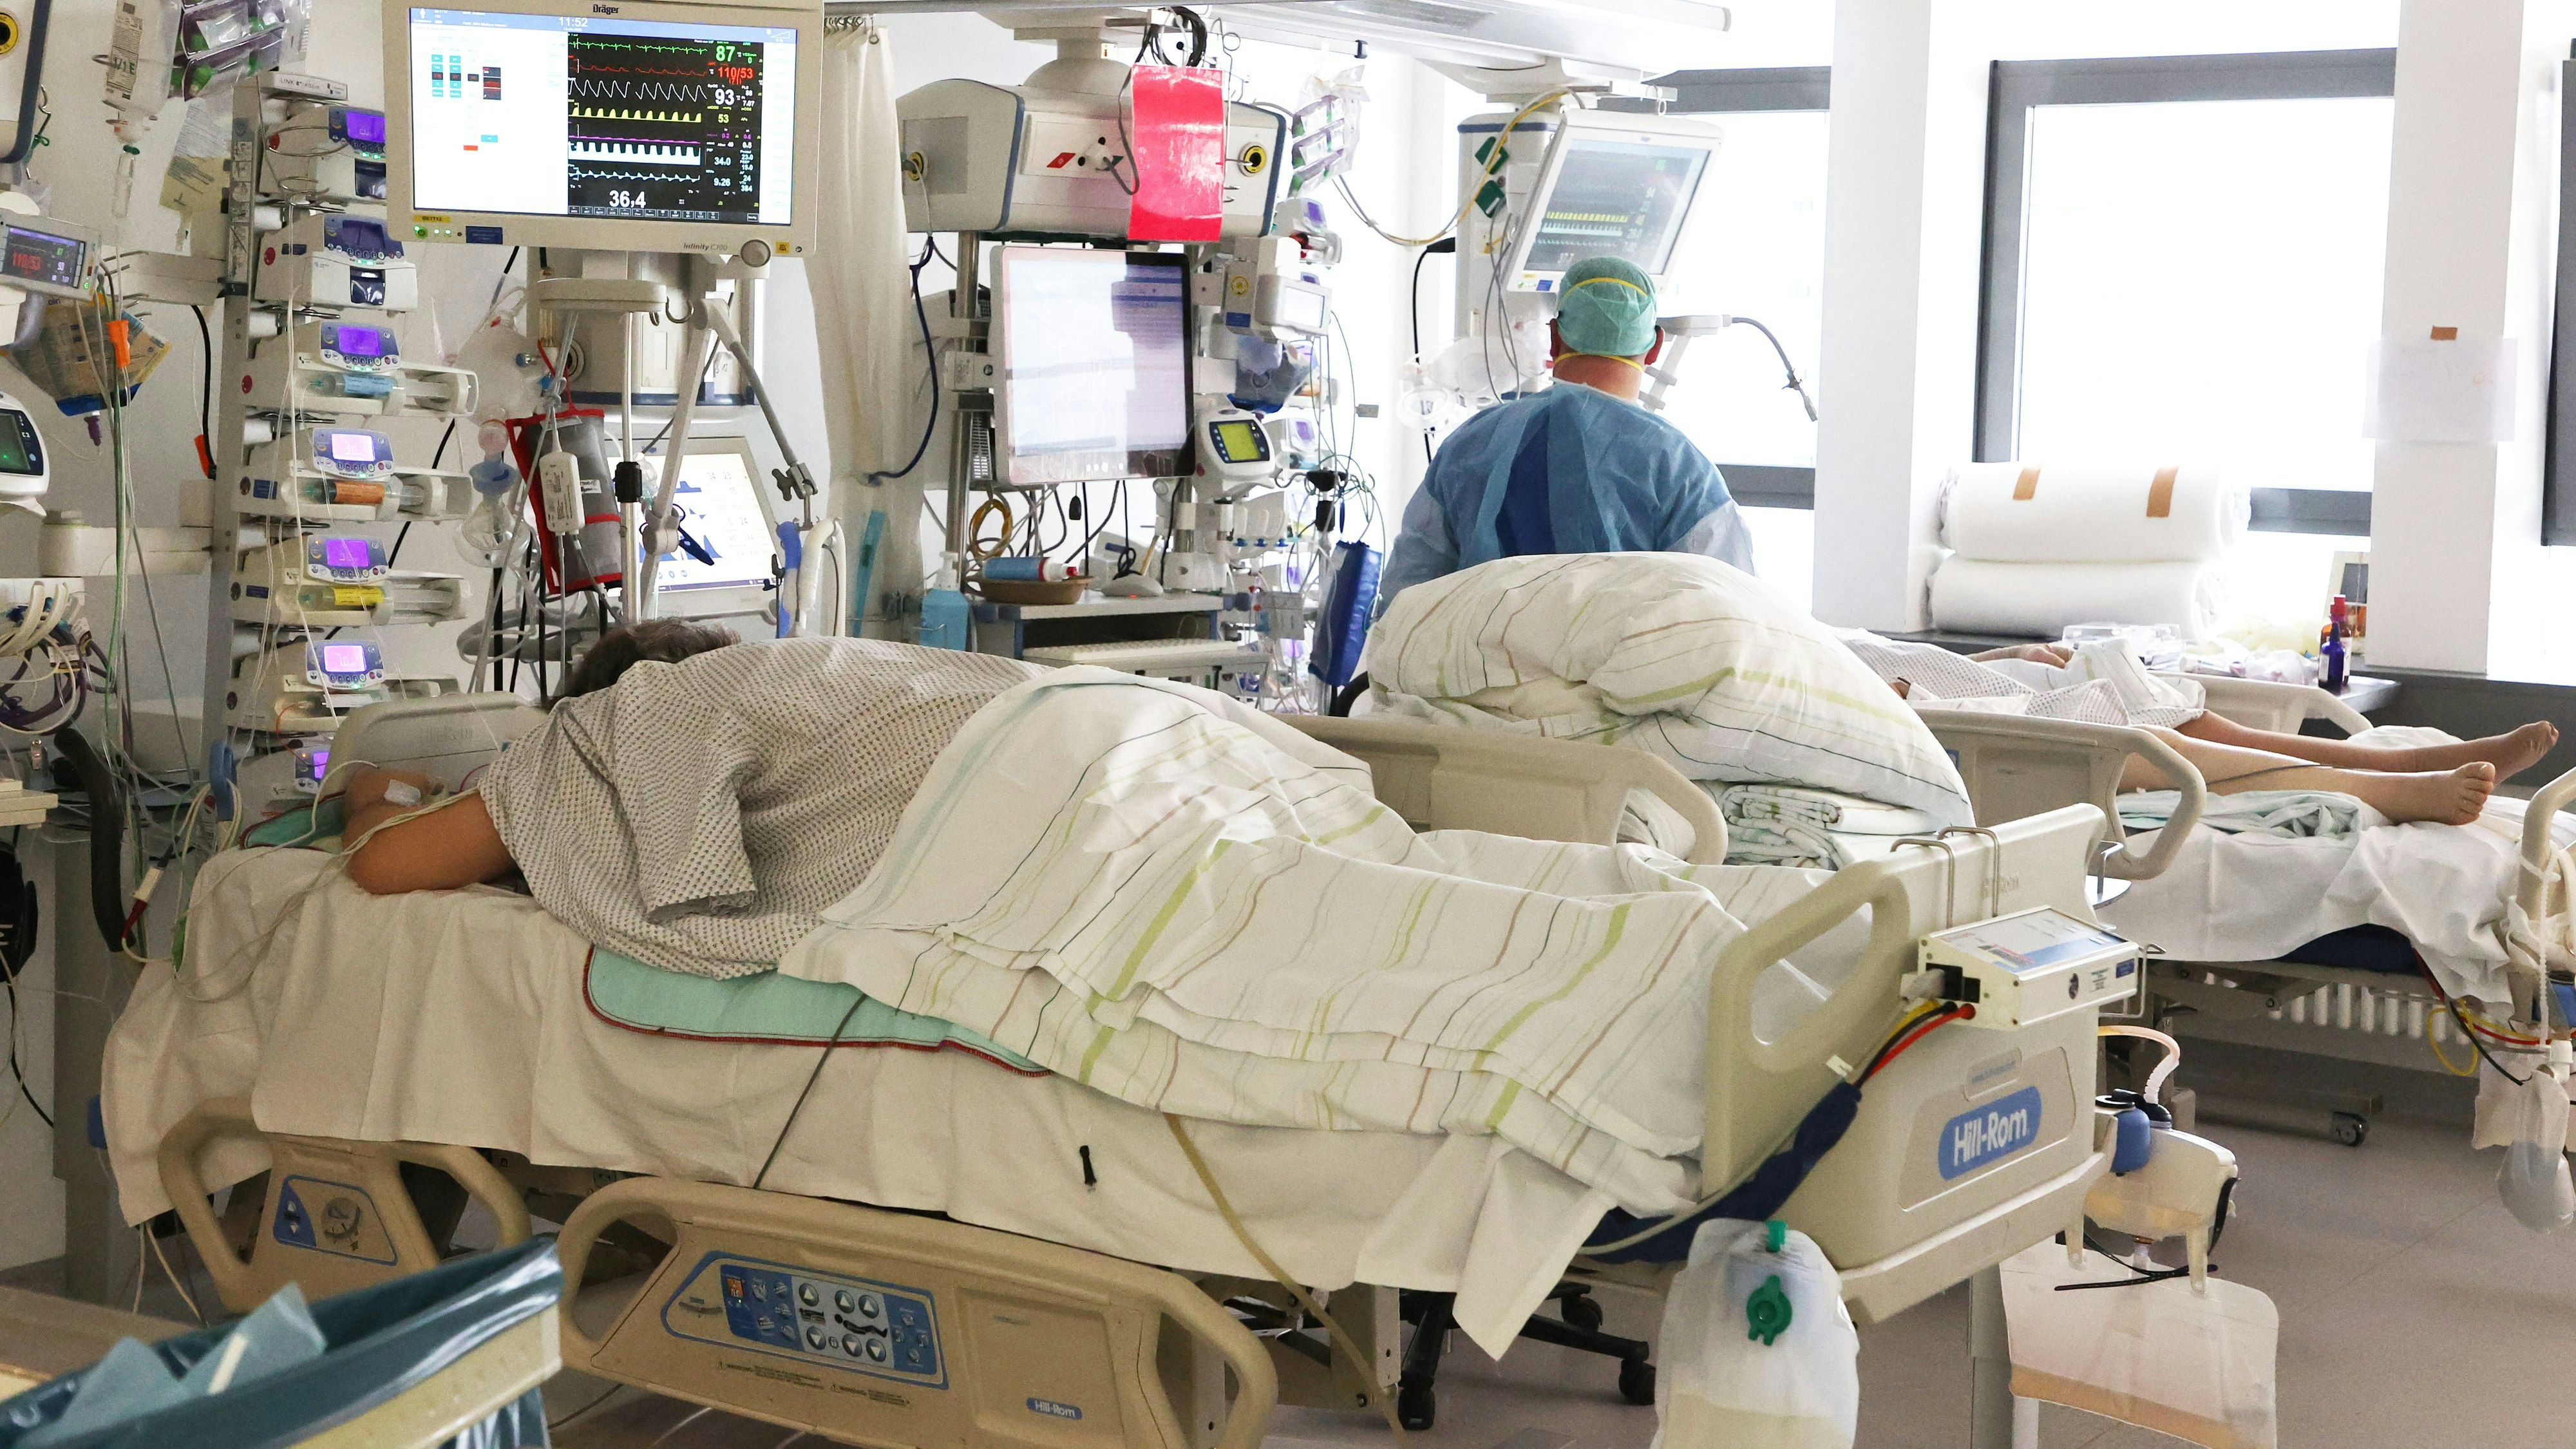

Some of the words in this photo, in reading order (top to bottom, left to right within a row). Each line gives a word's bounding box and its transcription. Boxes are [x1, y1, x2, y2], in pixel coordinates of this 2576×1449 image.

[593, 4, 619, 15] Dräger
[559, 16, 588, 27] 11:52
[716, 45, 735, 62] 87
[718, 67, 753, 79] 110/53
[715, 89, 734, 105] 93
[718, 114, 729, 123] 53
[609, 190, 646, 208] 36,4
[684, 243, 709, 251] Infinity
[1954, 1109, 2027, 1167] Hill-Rom
[1035, 1400, 1075, 1417] Hill-Rom
